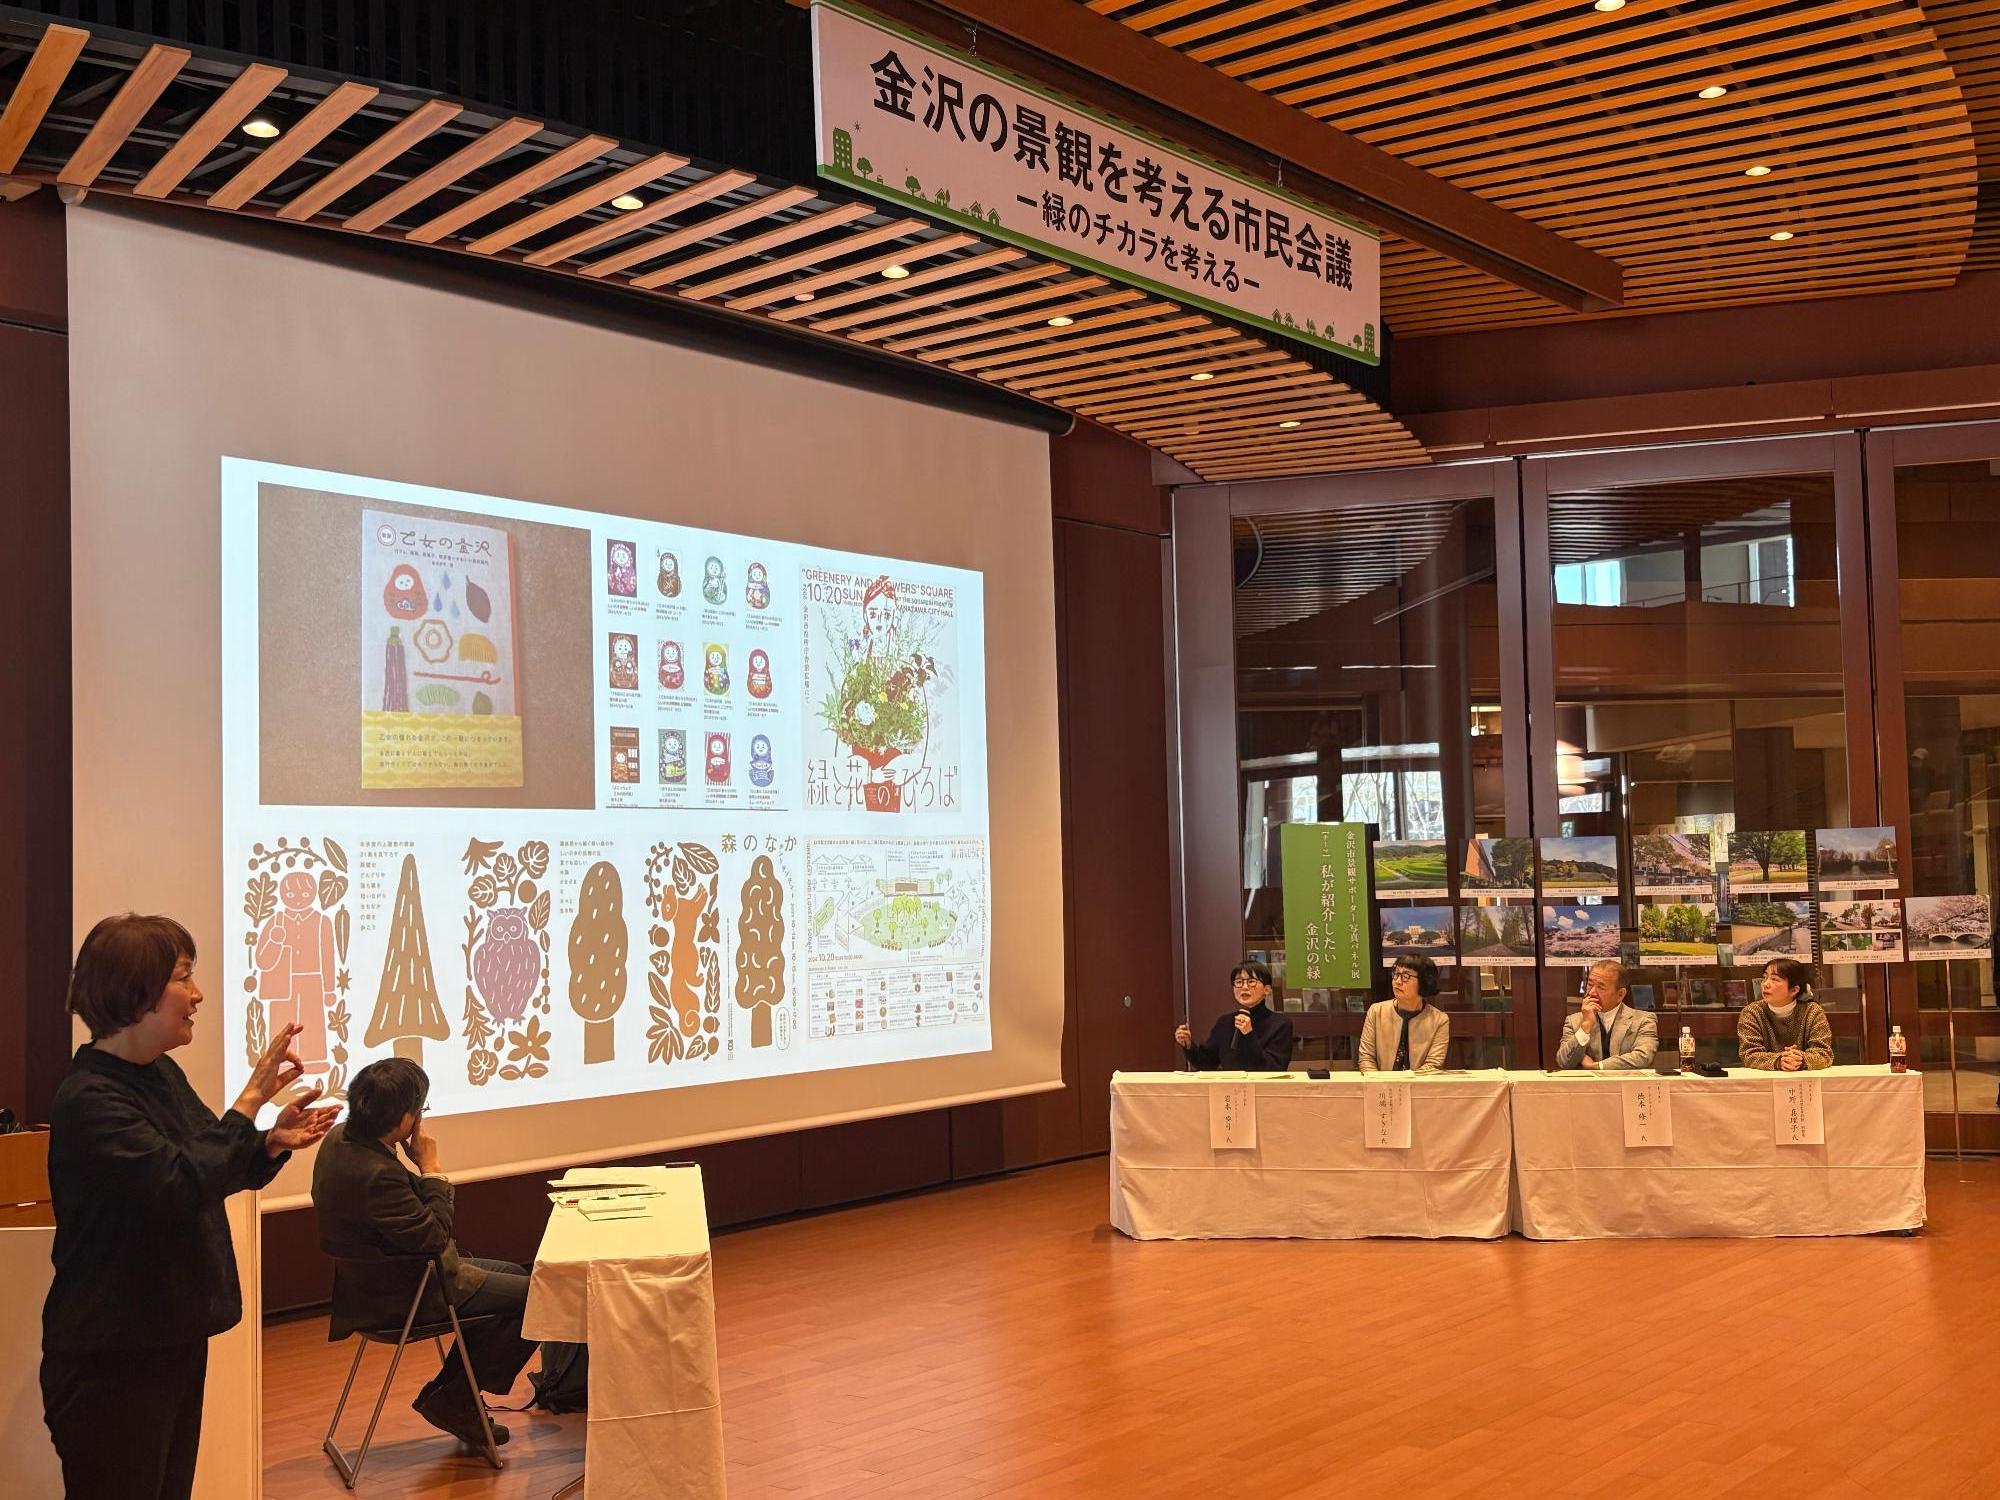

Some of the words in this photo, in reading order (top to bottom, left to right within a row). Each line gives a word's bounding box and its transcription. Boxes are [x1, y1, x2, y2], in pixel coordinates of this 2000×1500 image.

[870, 50, 1353, 292] 金沢の景観を考える市民会議
[400, 531, 492, 557] 乙女の金沢
[809, 583, 842, 605] 10.20
[843, 588, 864, 602] SUN
[921, 585, 954, 600] SQUARE
[807, 760, 958, 814] 緑と花のひろば
[721, 833, 797, 853] 森のなか
[1321, 865, 1337, 963] 私が紹介したい
[1306, 922, 1321, 980] 金沢の緑
